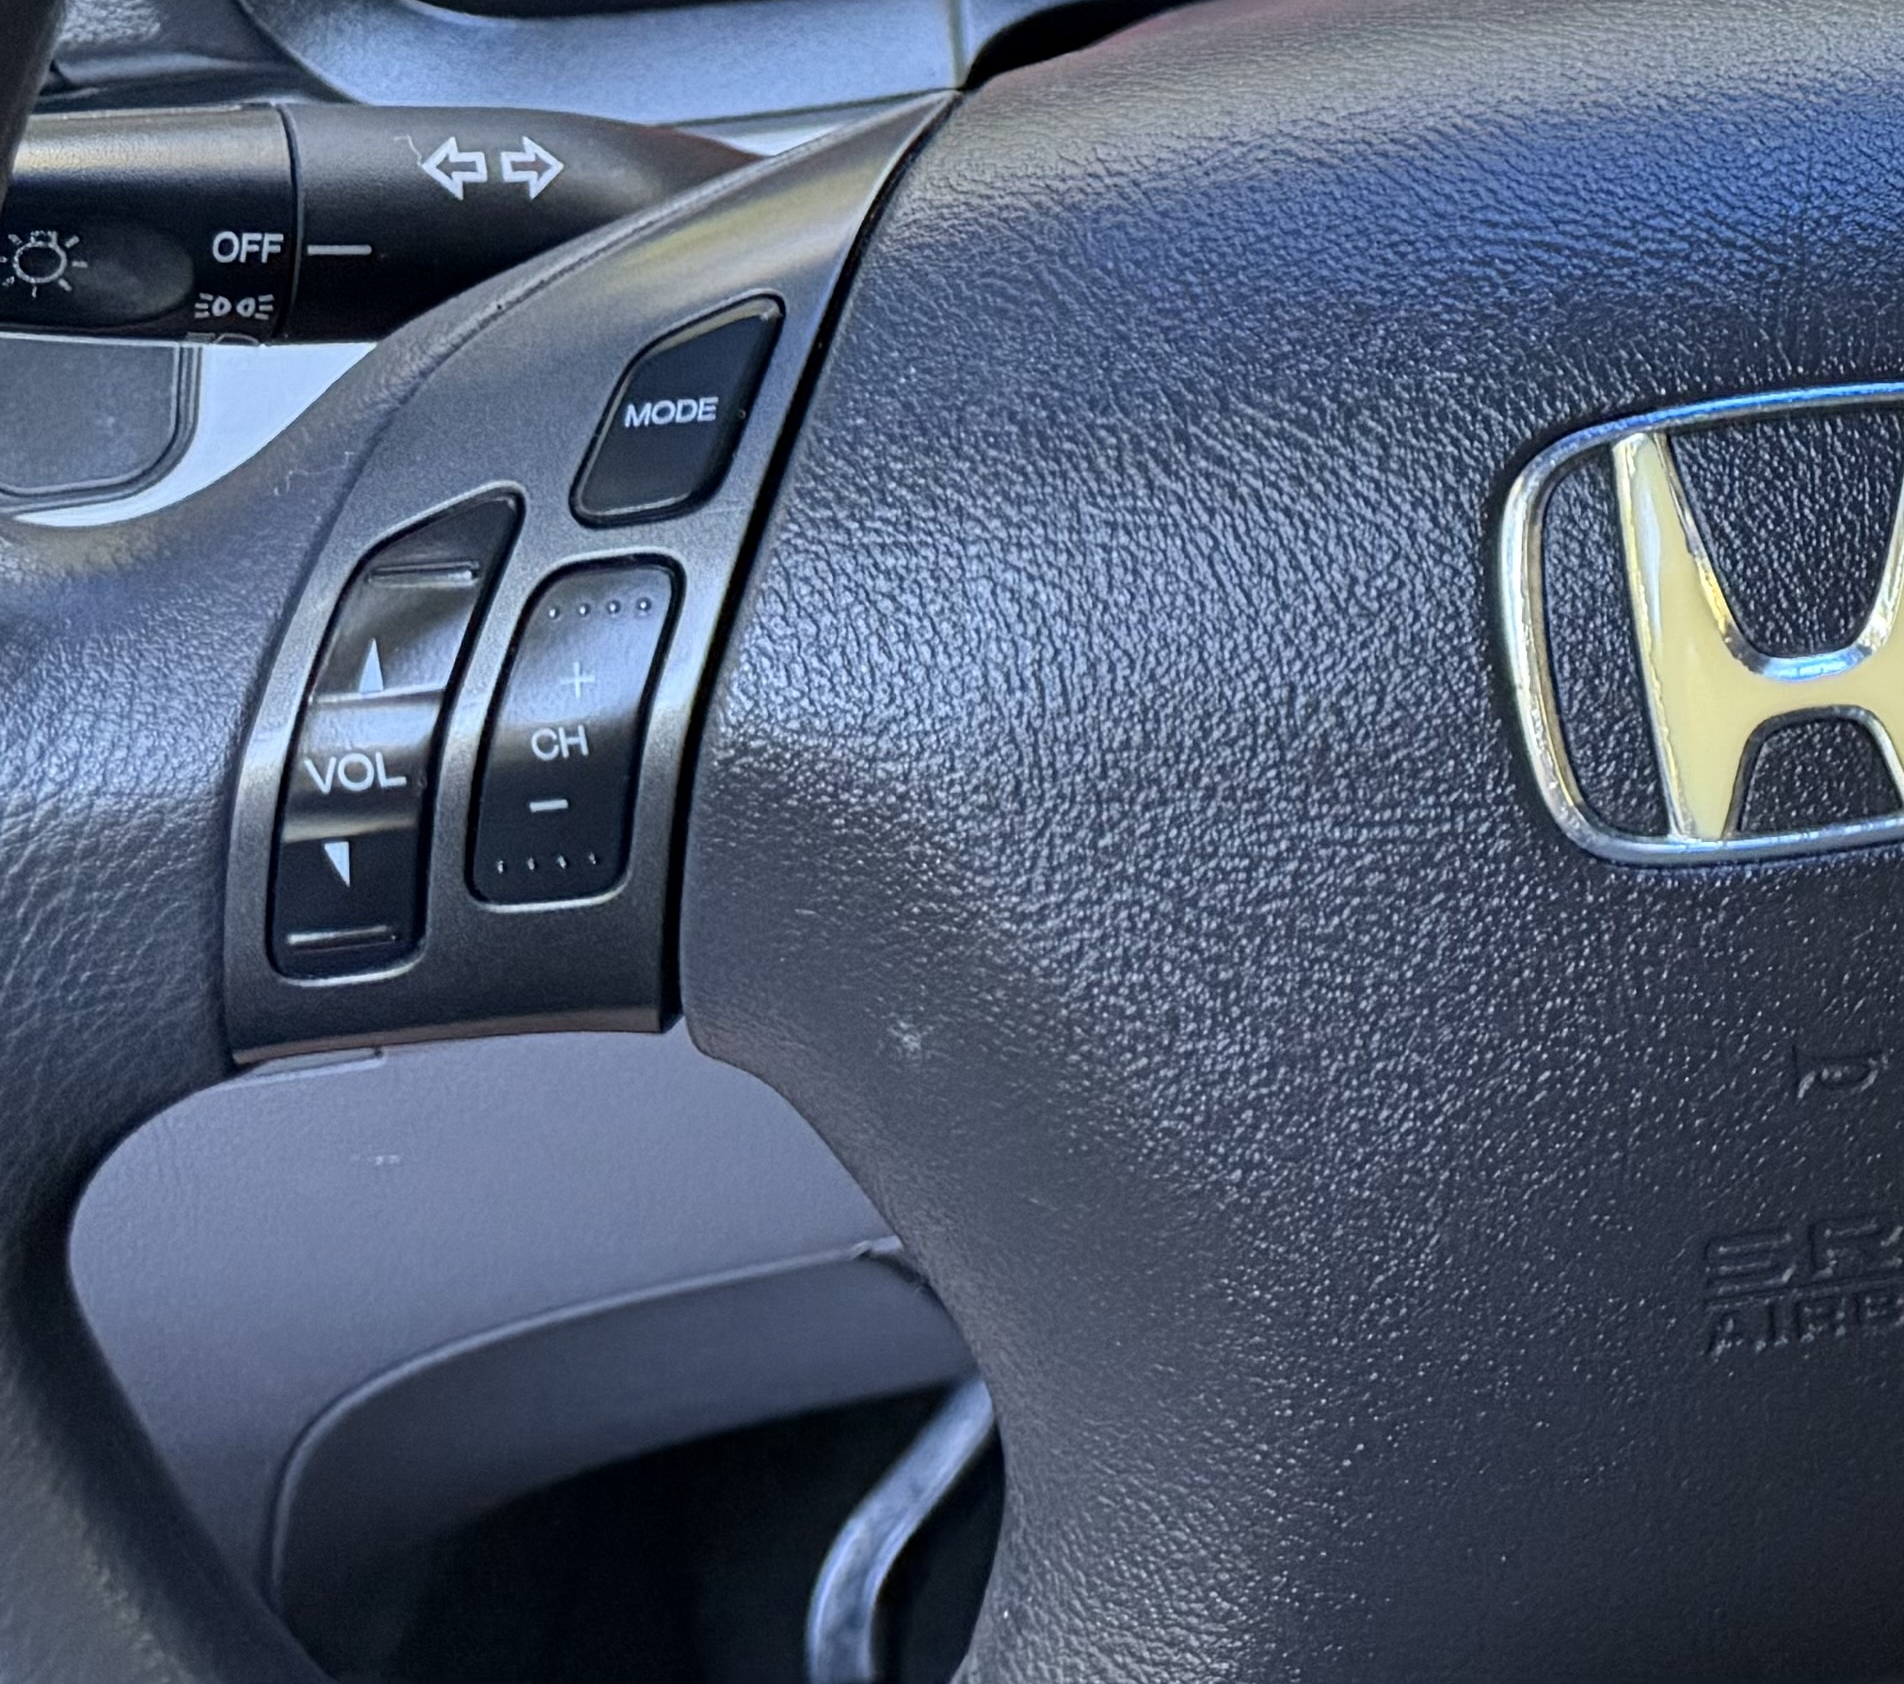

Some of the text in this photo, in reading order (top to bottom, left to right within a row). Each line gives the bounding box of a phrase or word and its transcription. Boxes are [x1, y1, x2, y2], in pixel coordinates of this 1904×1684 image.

[211, 231, 285, 263] OFF
[624, 396, 718, 428] MODE
[531, 725, 590, 763] CH
[304, 750, 408, 795] VOL
